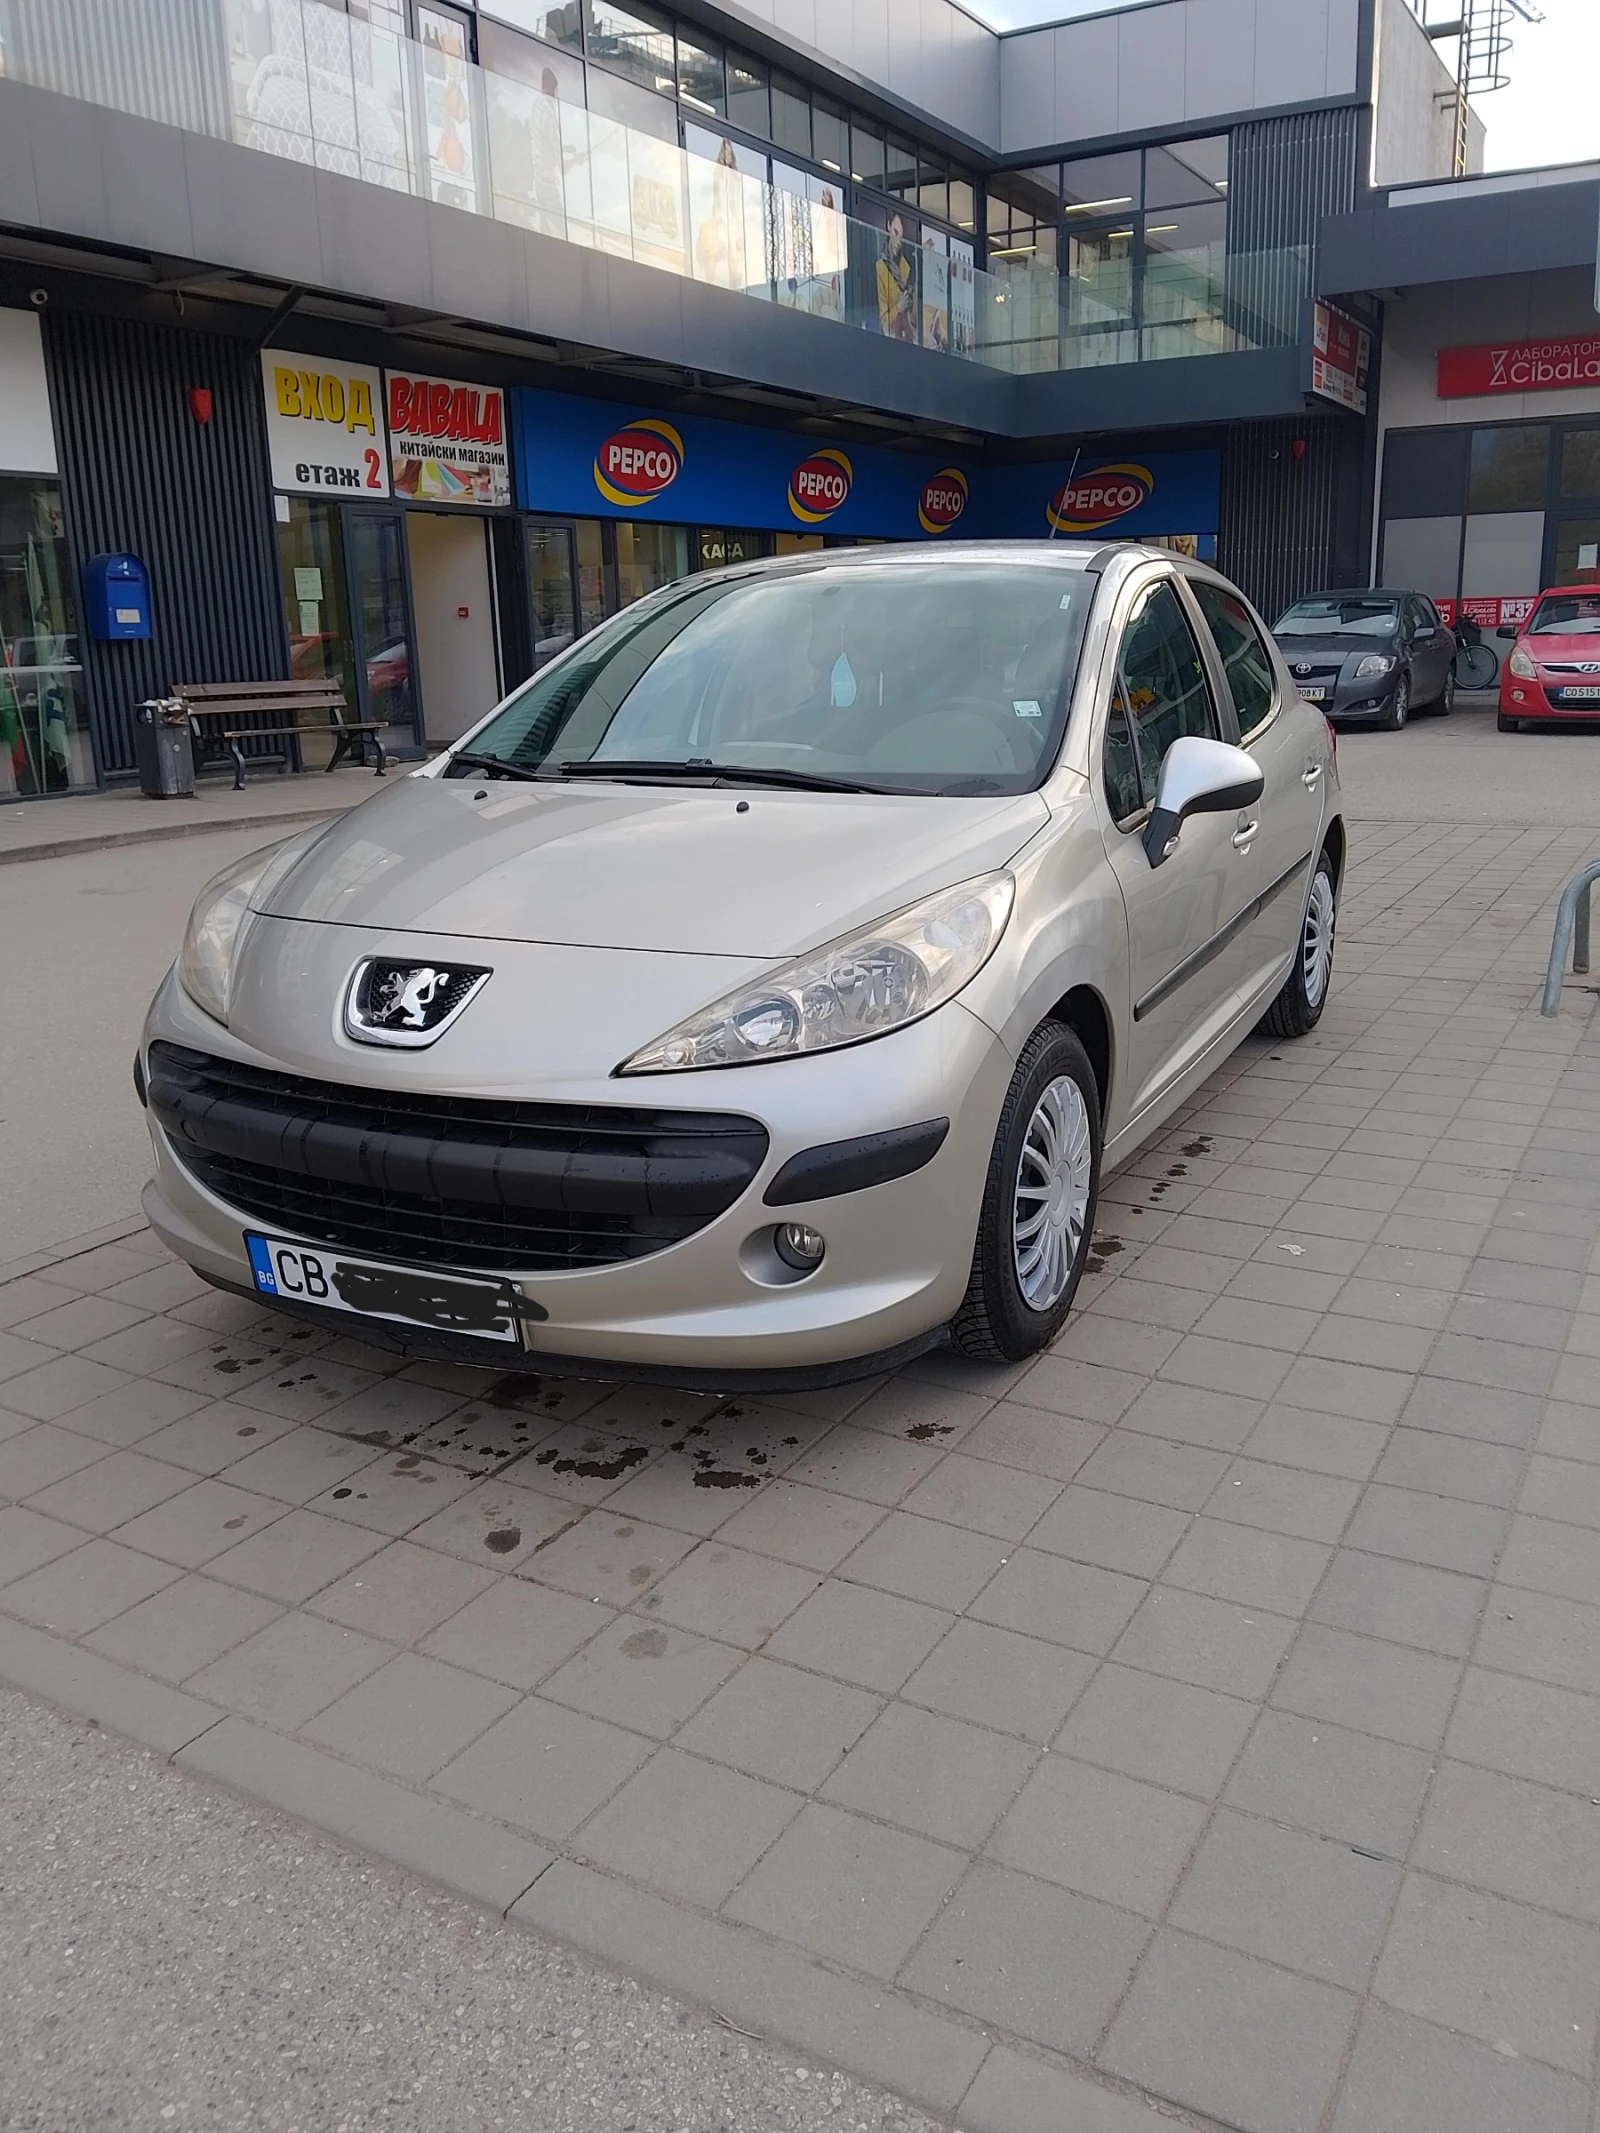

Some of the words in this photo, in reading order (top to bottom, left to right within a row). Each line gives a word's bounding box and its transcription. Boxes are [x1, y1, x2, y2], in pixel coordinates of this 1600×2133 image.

[274, 366, 375, 436] ВХОД
[389, 377, 503, 445] BABALA
[295, 462, 361, 488] етаж
[364, 448, 381, 488] 2
[400, 441, 457, 460] китайски
[458, 448, 505, 466] магазин
[608, 445, 671, 479] PEPCO
[798, 471, 844, 499] PEPCO
[926, 488, 961, 512] PEPCO
[1062, 485, 1136, 510] PEPCO
[258, 1270, 275, 1286] BG
[276, 1249, 329, 1298] CB
